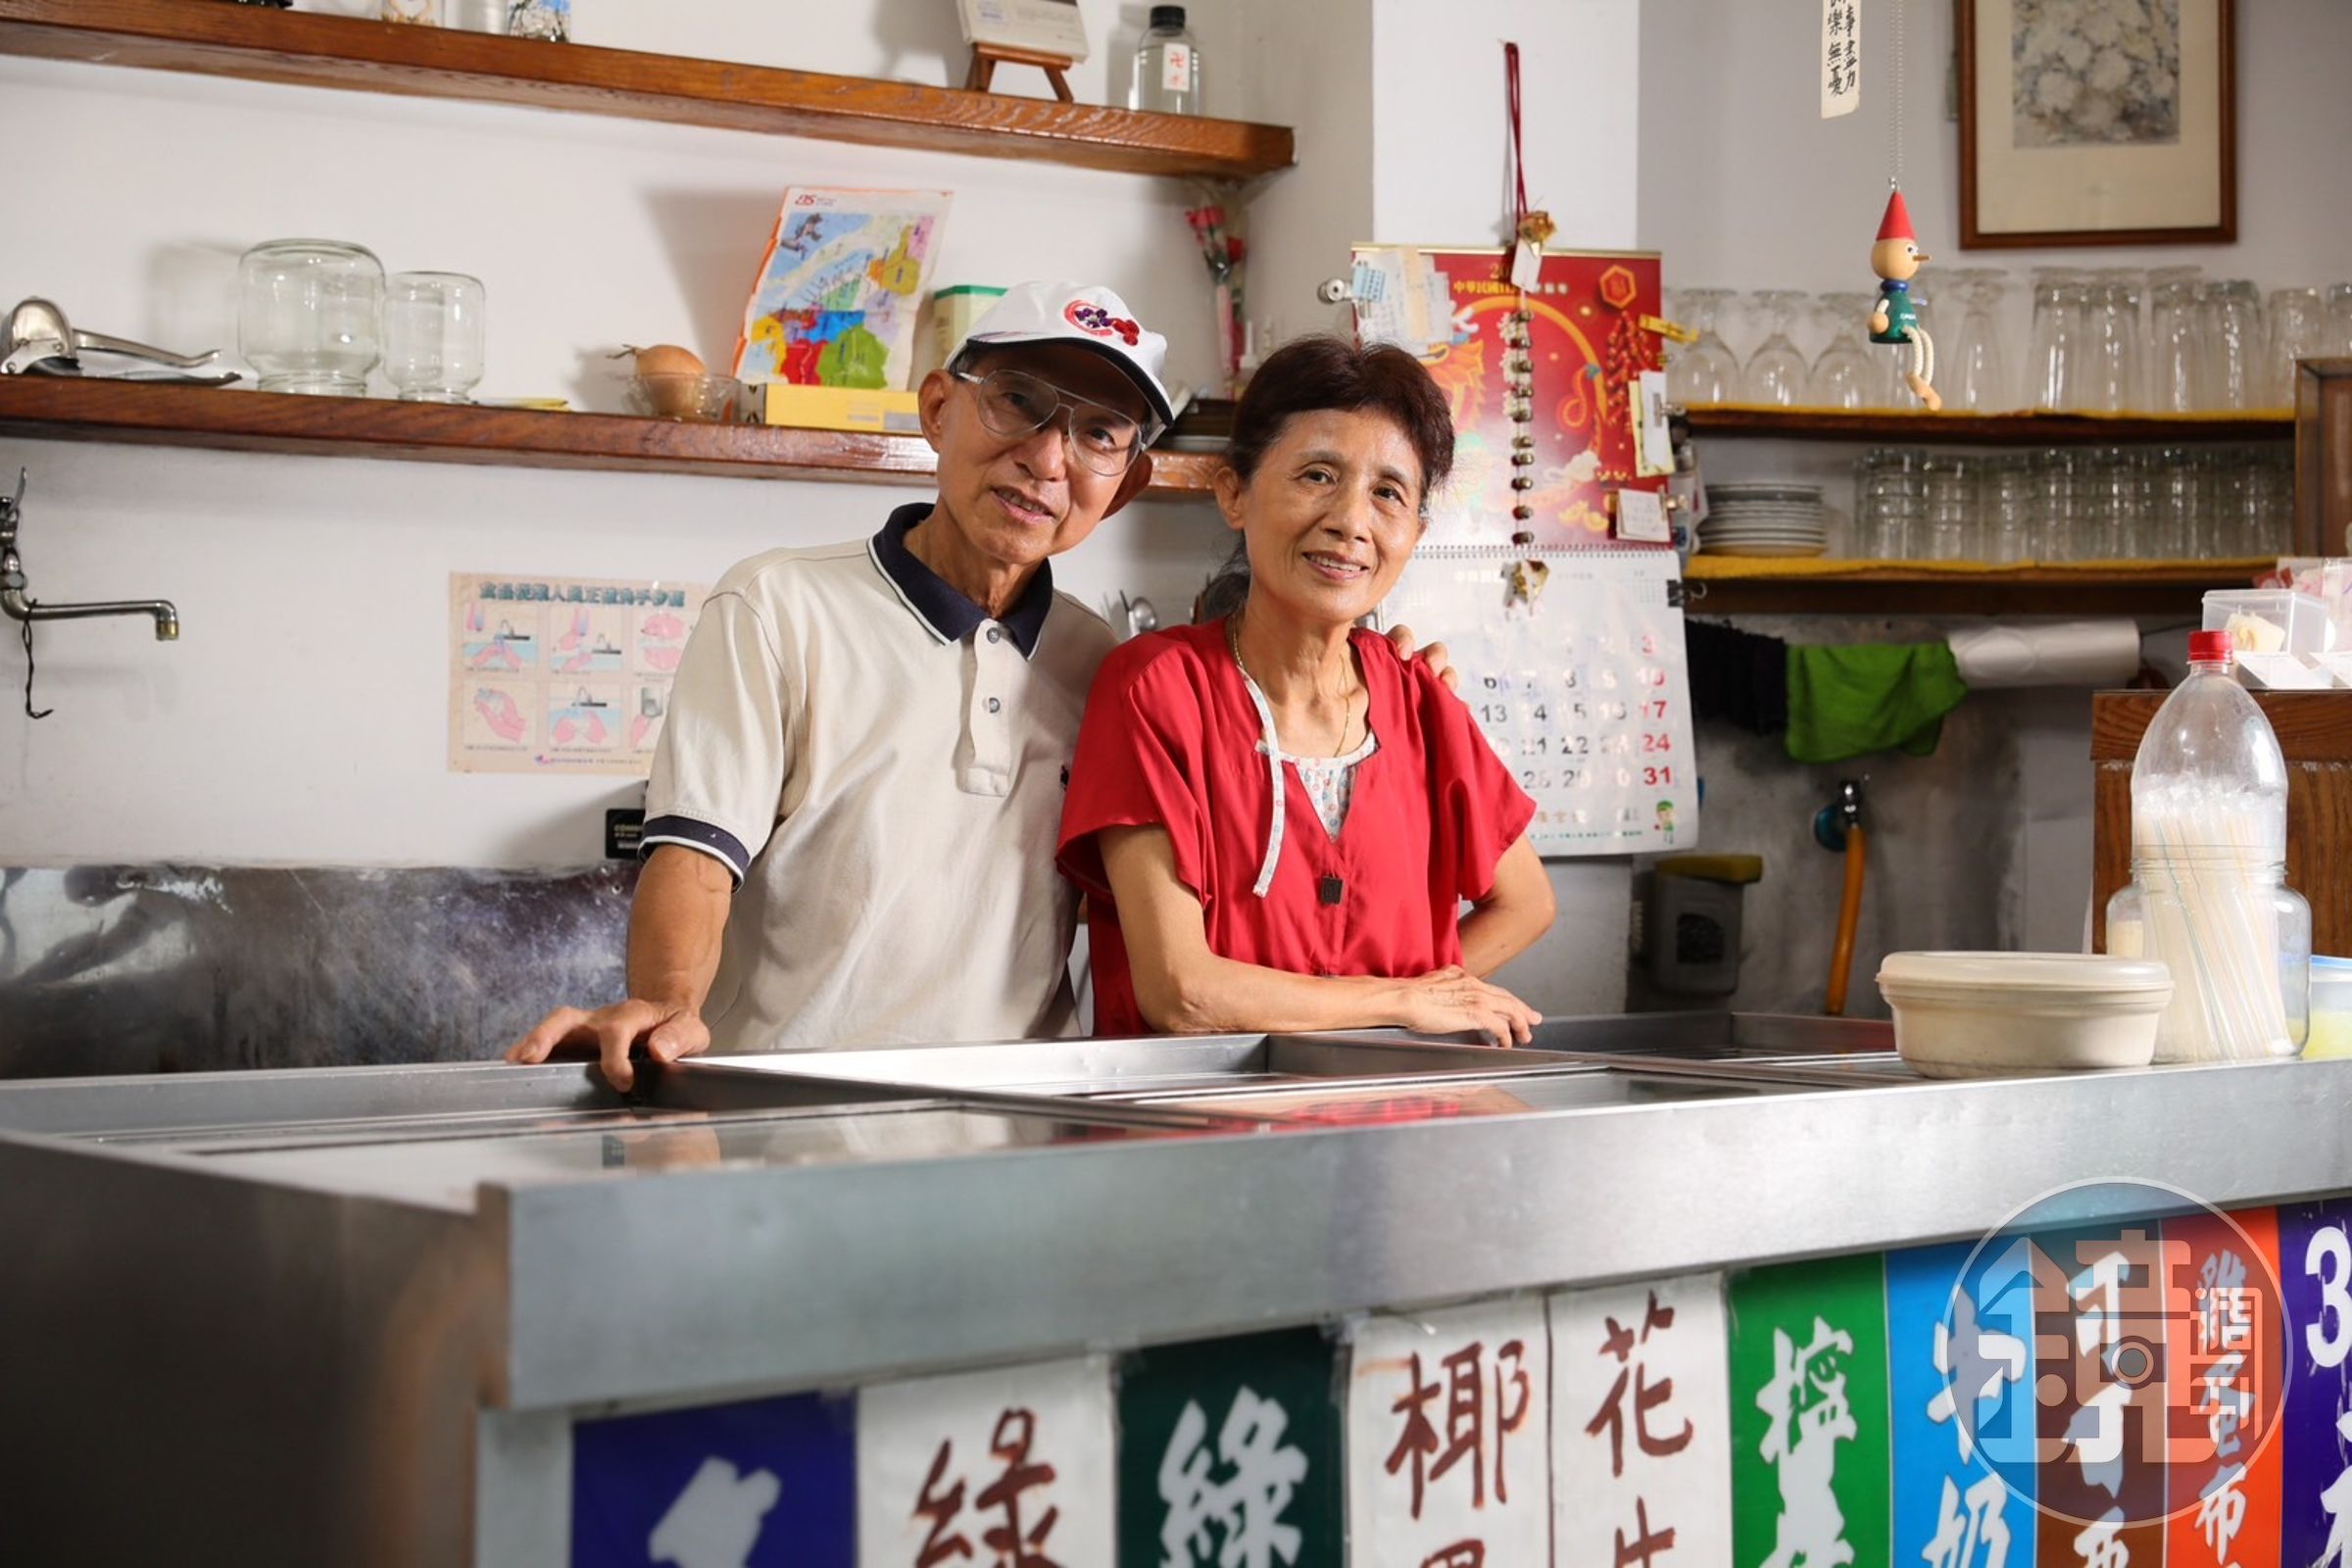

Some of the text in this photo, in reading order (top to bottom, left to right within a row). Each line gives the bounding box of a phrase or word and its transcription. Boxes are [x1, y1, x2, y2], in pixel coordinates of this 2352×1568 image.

[1481, 705, 1507, 722] 13
[1640, 701, 1667, 718] 17
[1561, 736, 1589, 755] 22
[1642, 733, 1671, 753] 24
[1643, 766, 1672, 786] 31
[2195, 1250, 2256, 1568] 雞蛋布
[1385, 1340, 1530, 1568] 椰
